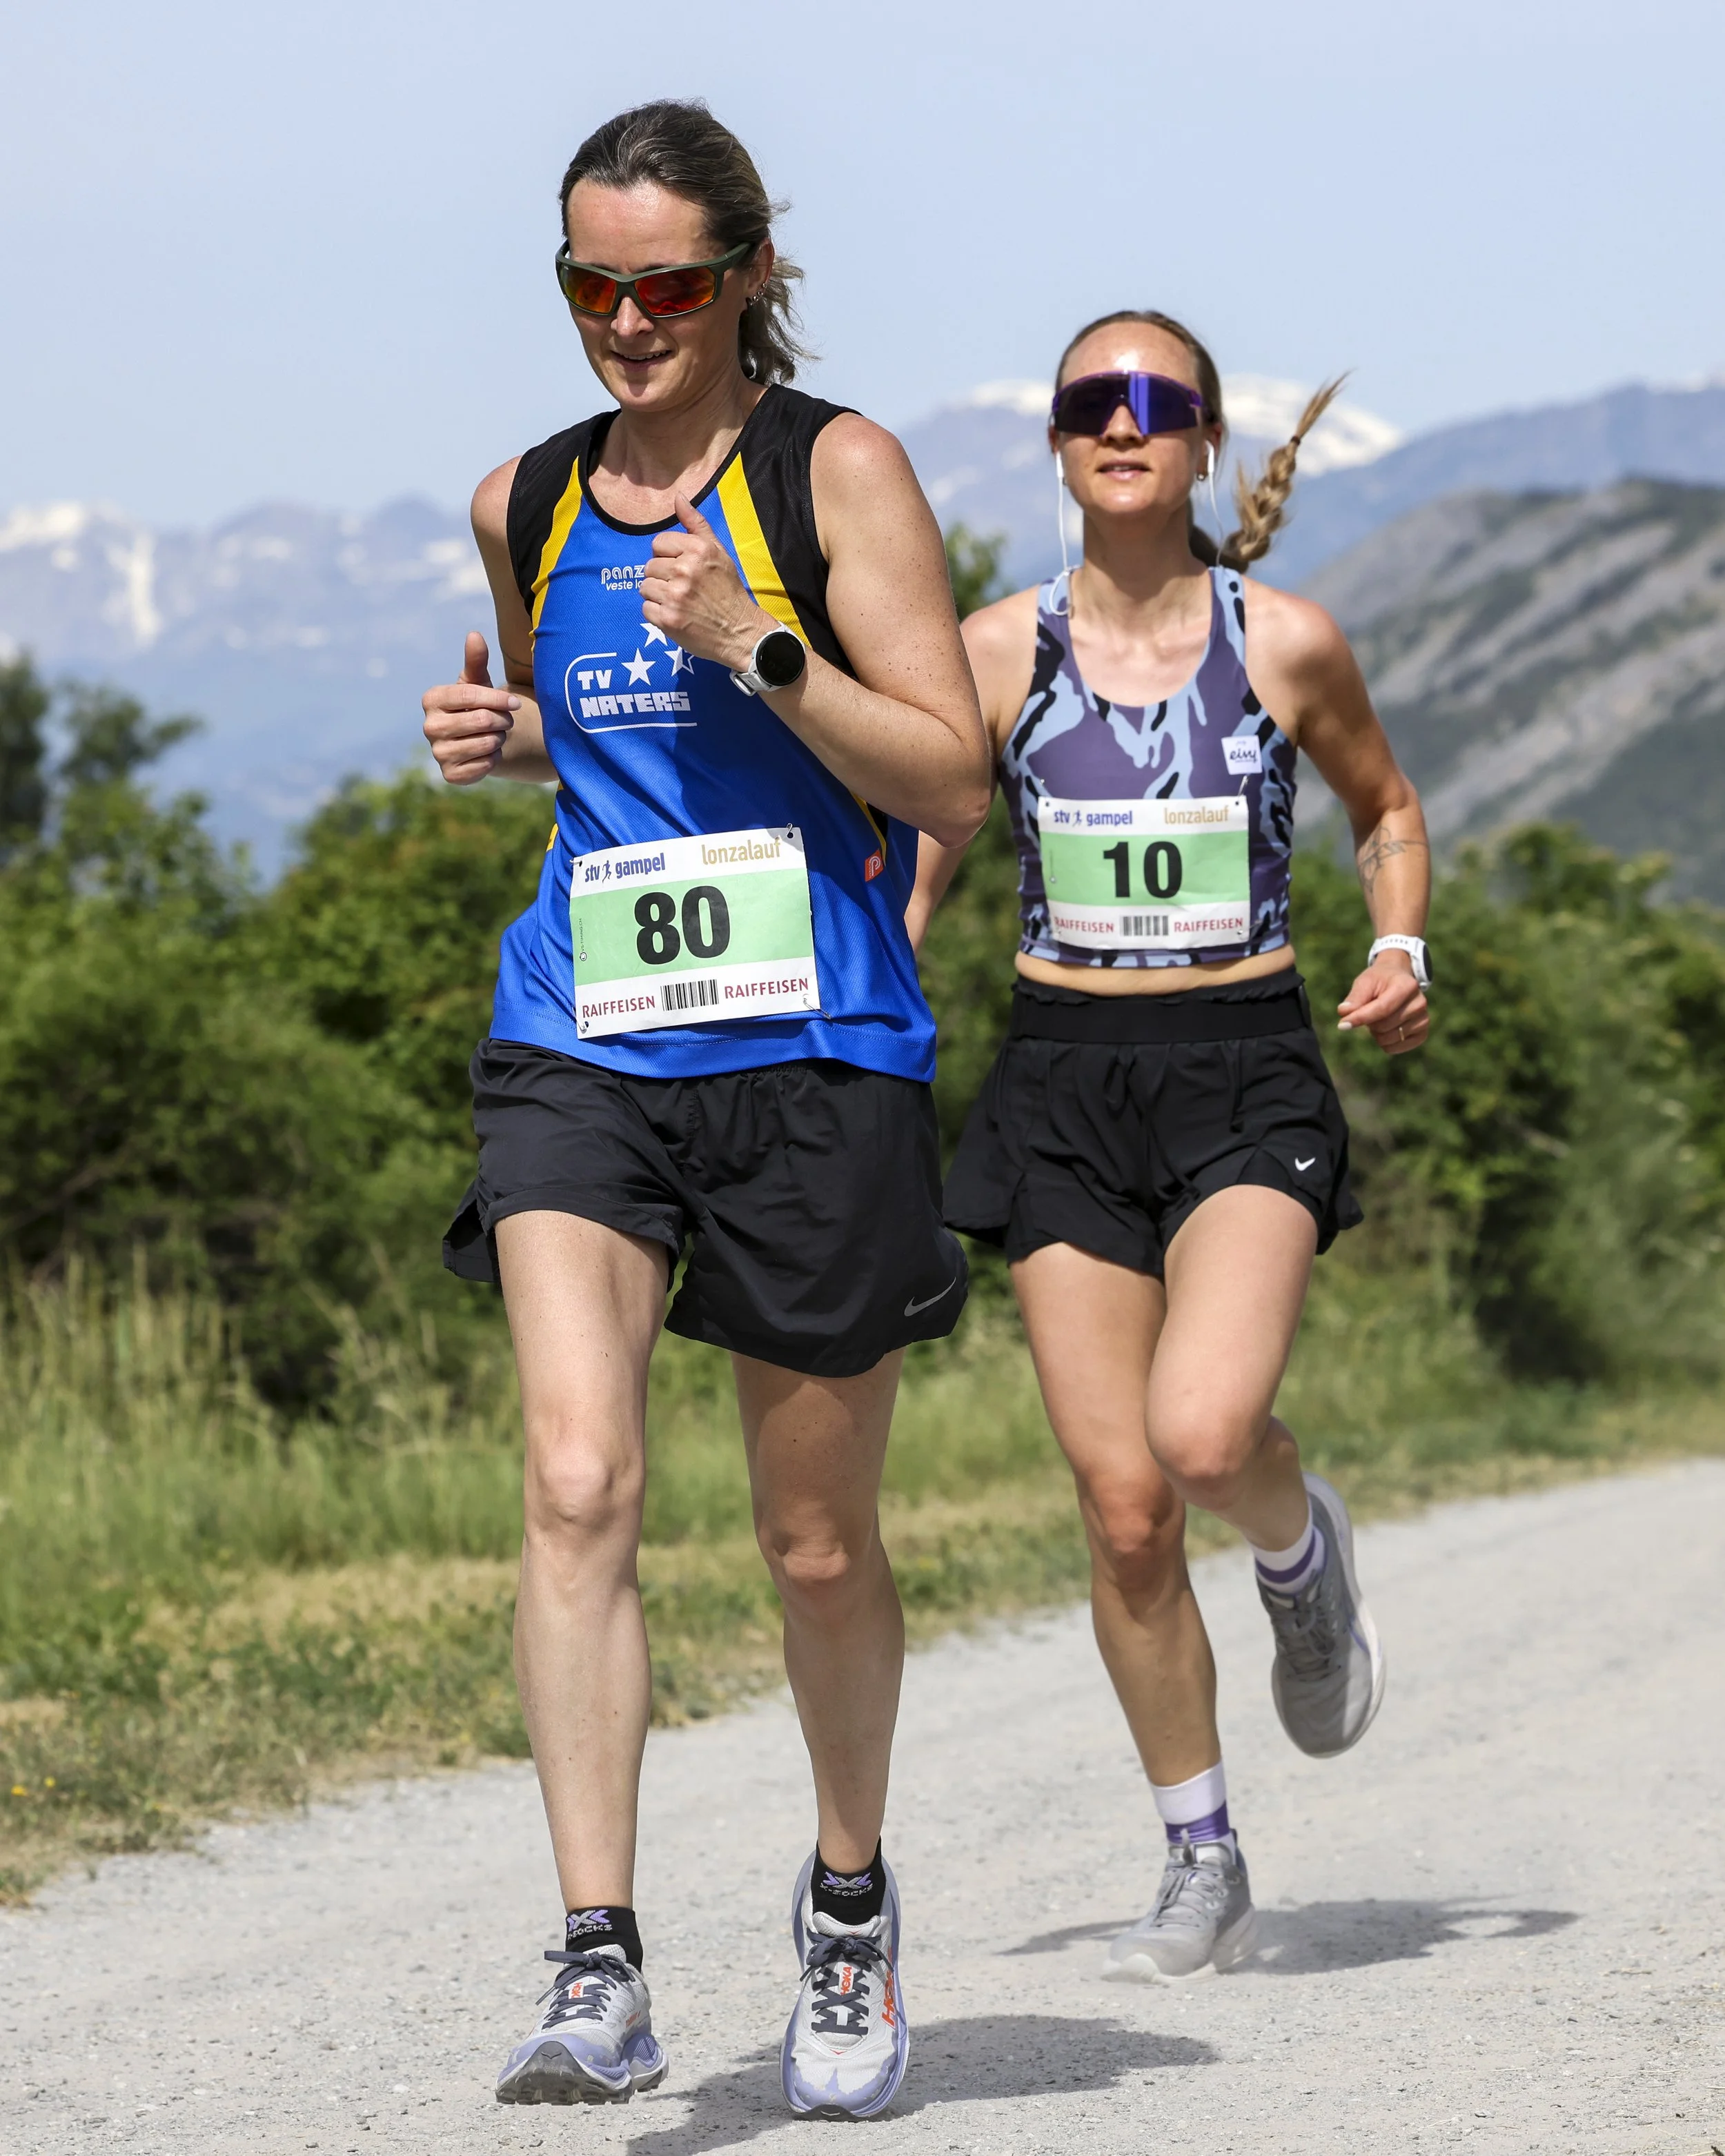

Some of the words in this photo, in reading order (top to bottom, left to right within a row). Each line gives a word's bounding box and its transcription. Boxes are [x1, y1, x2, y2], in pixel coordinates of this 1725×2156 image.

[606, 580, 633, 591] veste
[577, 669, 613, 690] TV
[580, 691, 691, 718] NATERS
[1054, 809, 1070, 823] stv
[1087, 810, 1133, 827] gampel
[1164, 805, 1230, 824] lonzalauf
[702, 837, 782, 865] lonzalauf
[584, 864, 600, 883] stv
[615, 852, 666, 880] gampel
[1103, 840, 1183, 900] 10
[634, 885, 731, 965] 80
[1054, 916, 1114, 933] RAIFFEISEN
[1174, 917, 1244, 932] RAIFFEISEN
[724, 978, 809, 999] RAIFFEISEN
[582, 996, 656, 1018] RAIFFEISEN
